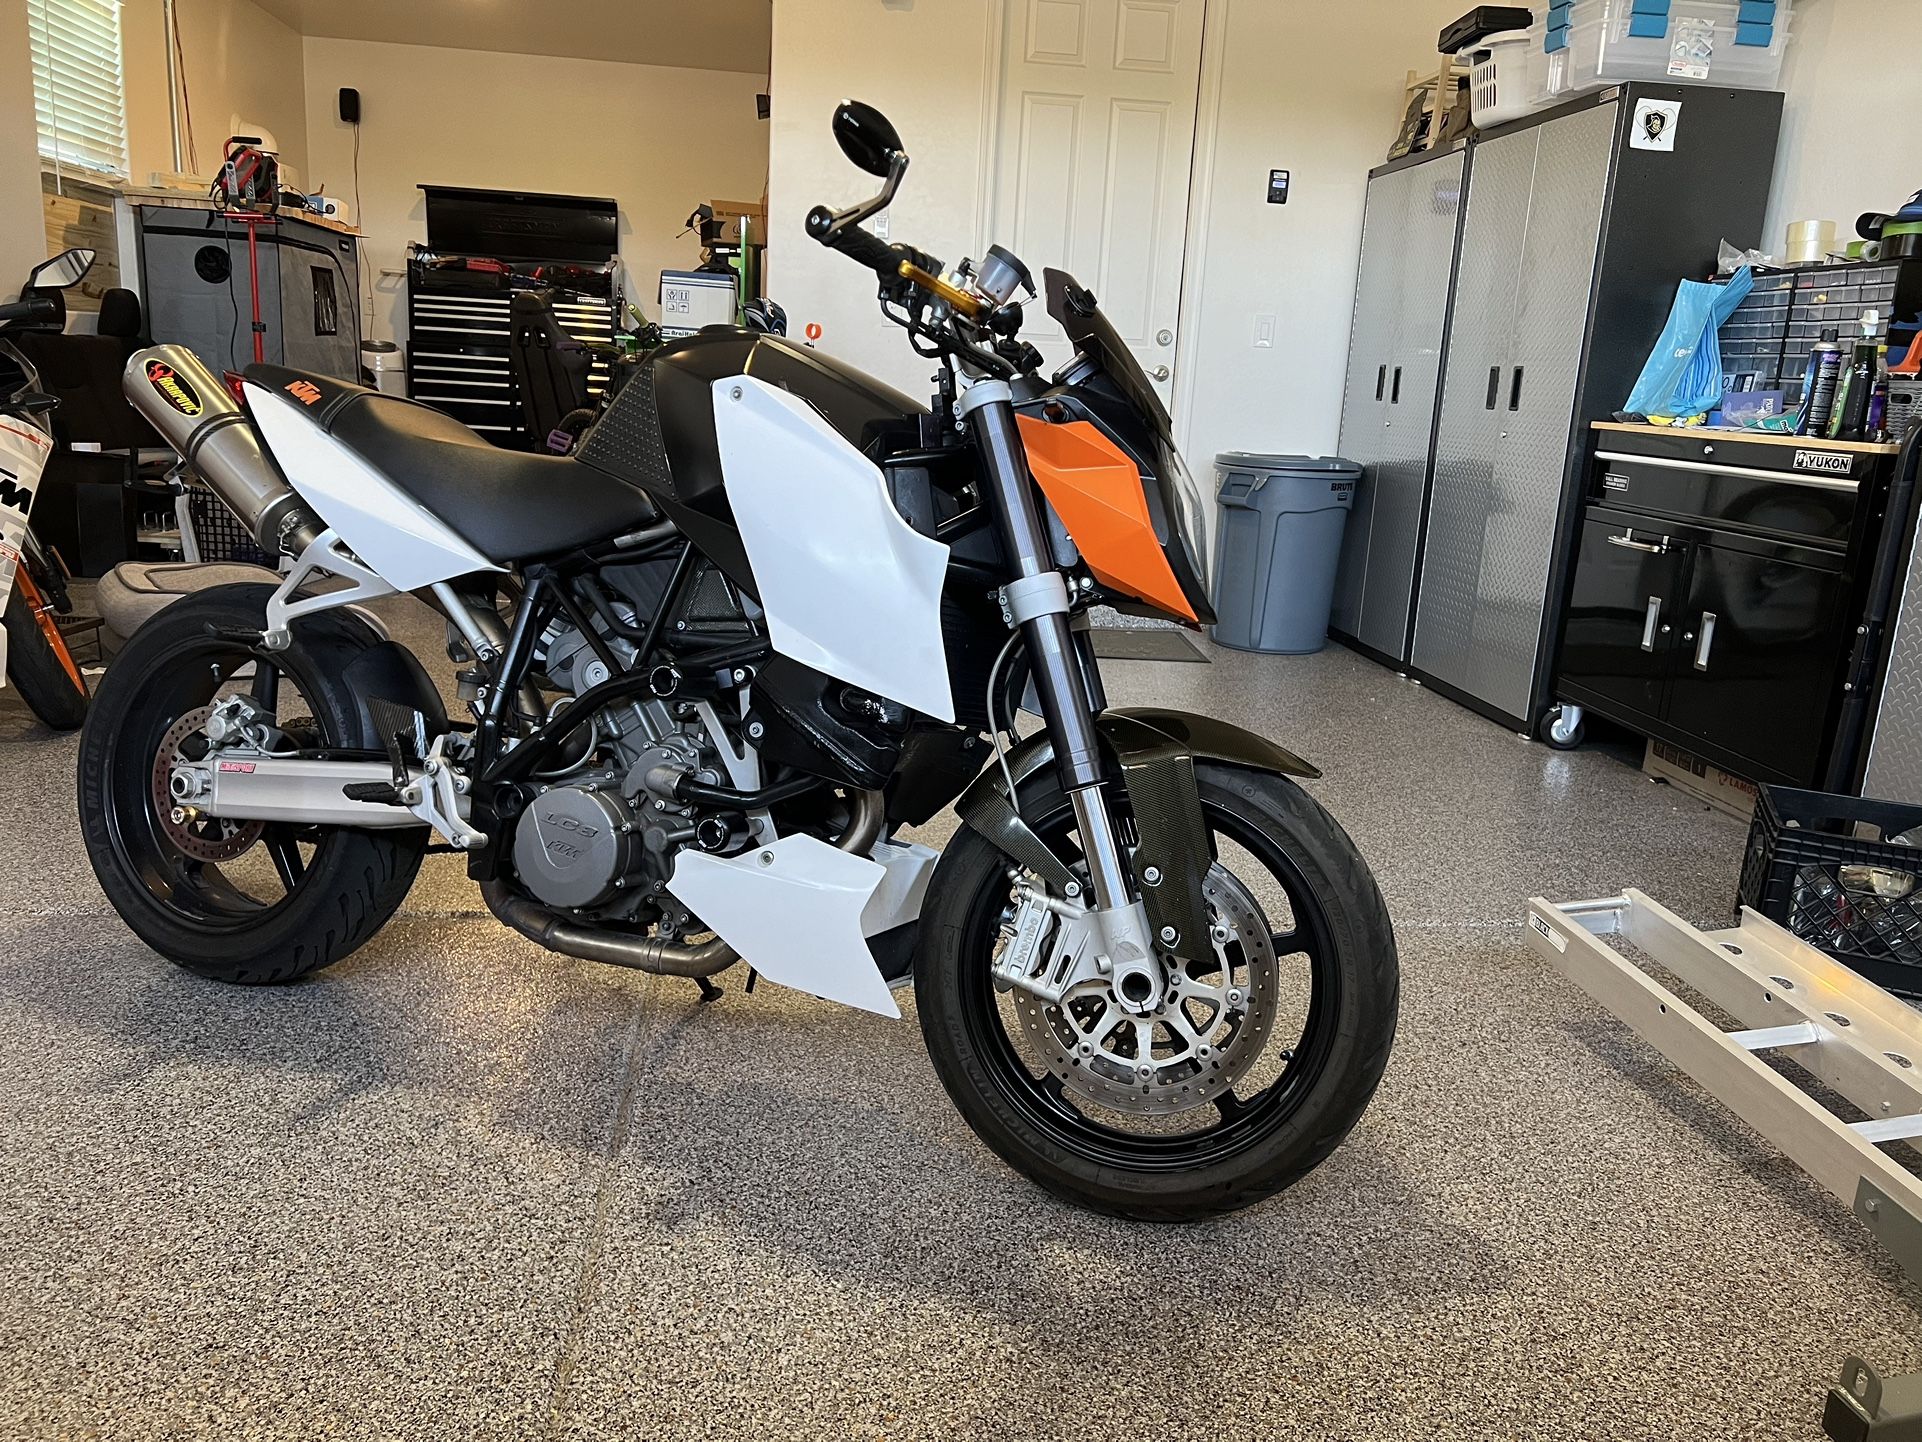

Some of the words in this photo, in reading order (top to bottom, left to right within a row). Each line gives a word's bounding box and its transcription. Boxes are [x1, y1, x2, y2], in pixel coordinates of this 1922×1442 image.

[284, 380, 322, 406] KTM
[1809, 455, 1849, 470] YUKON
[1014, 916, 1039, 964] brembo
